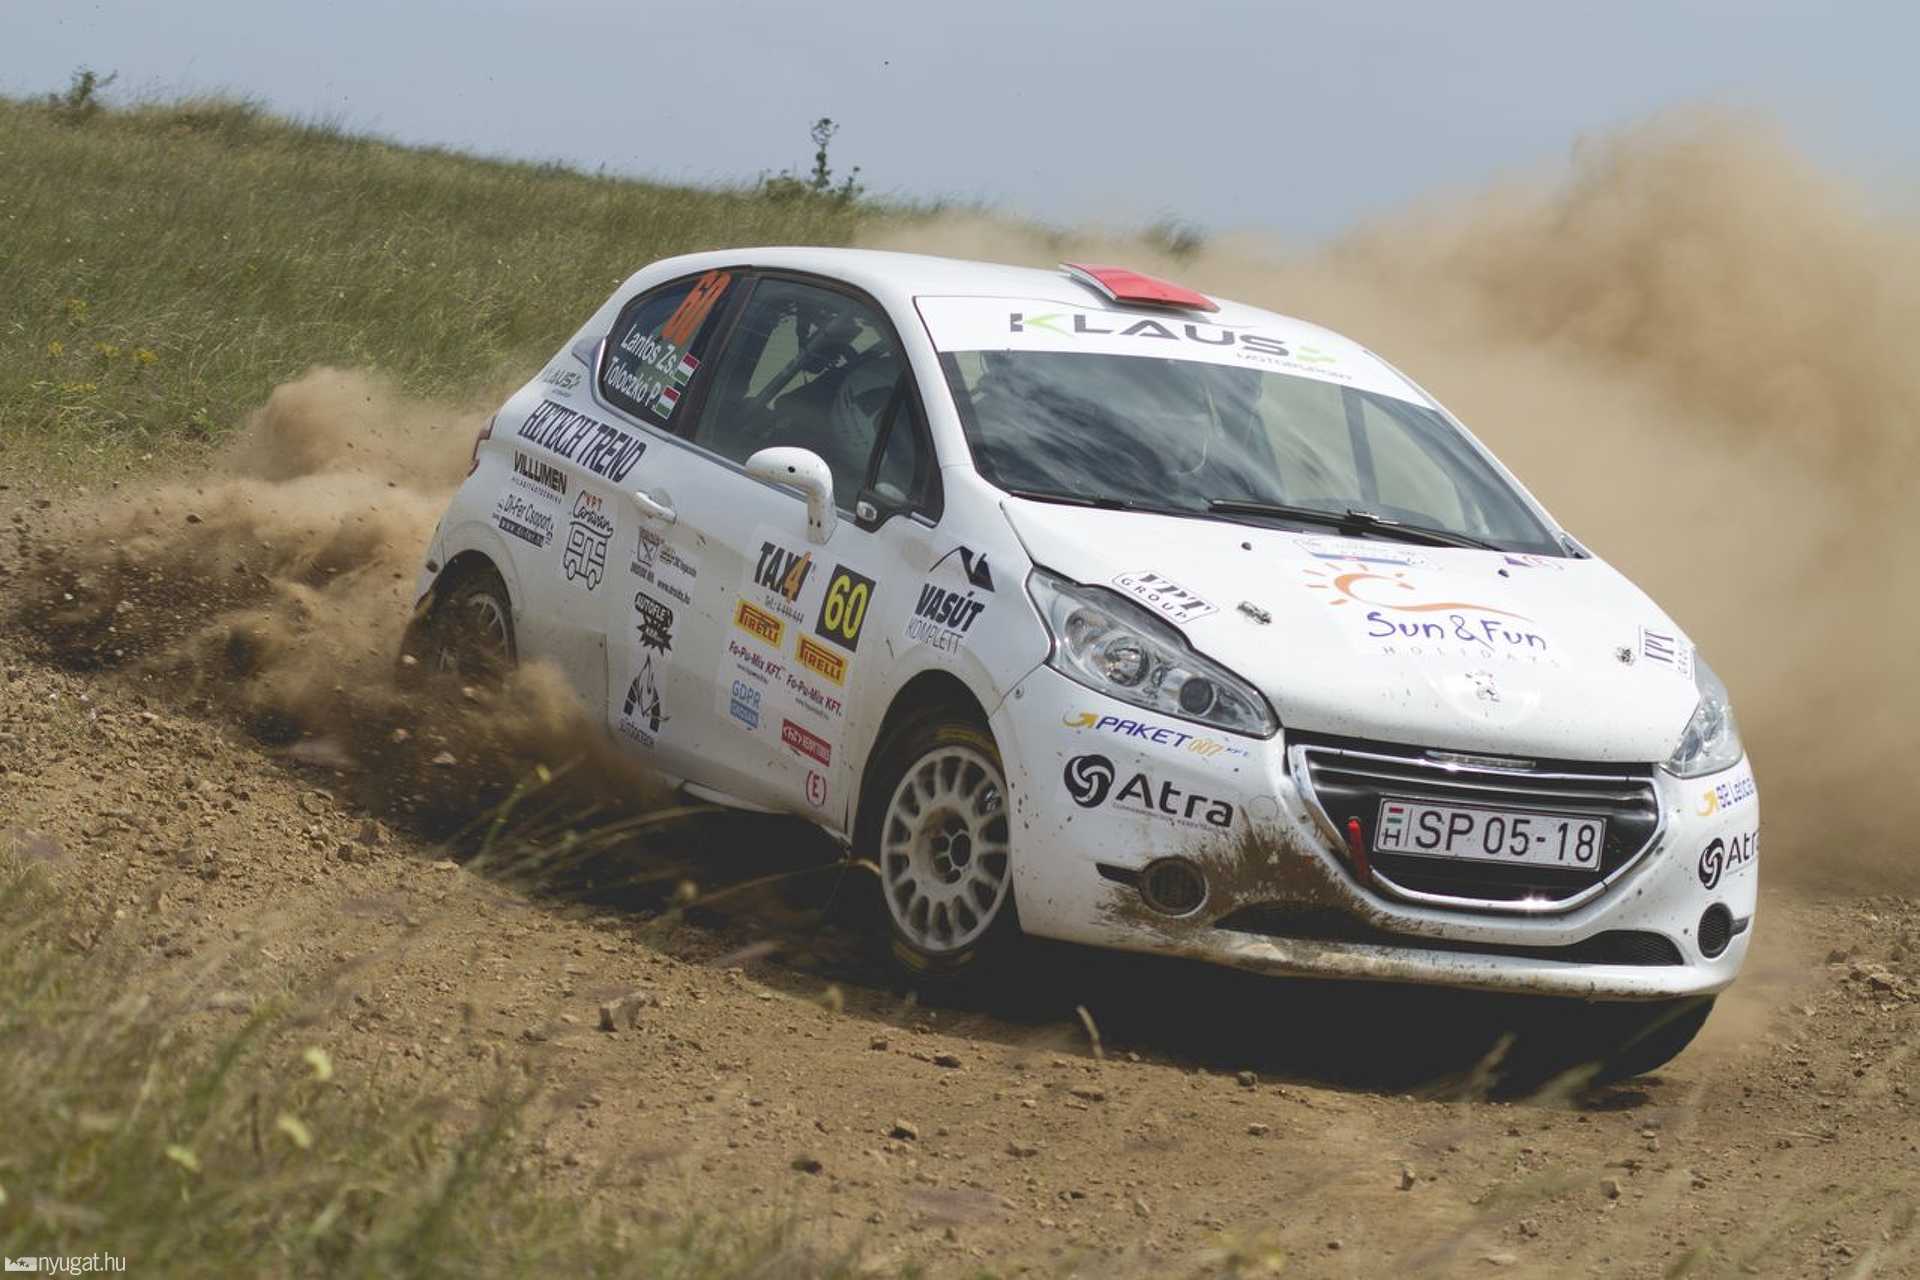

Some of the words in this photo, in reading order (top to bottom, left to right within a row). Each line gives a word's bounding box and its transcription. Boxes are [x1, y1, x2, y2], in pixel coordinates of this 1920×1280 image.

[620, 322, 662, 365] Lantos
[1009, 312, 1289, 357] KLAUS
[517, 398, 599, 460] HETECH
[576, 422, 647, 483] TREND
[513, 449, 567, 495] VILLUMEN
[824, 575, 868, 639] 60
[915, 583, 985, 632] VASÚT
[1121, 577, 1188, 619] GROUP
[739, 604, 780, 644] PIRELLI
[905, 619, 964, 656] KOMPLETT
[799, 639, 844, 681] PIRELLI
[732, 680, 762, 710] GDPR
[1116, 773, 1234, 828] Atra
[1383, 828, 1400, 847] H
[1483, 816, 1597, 863] 05-18
